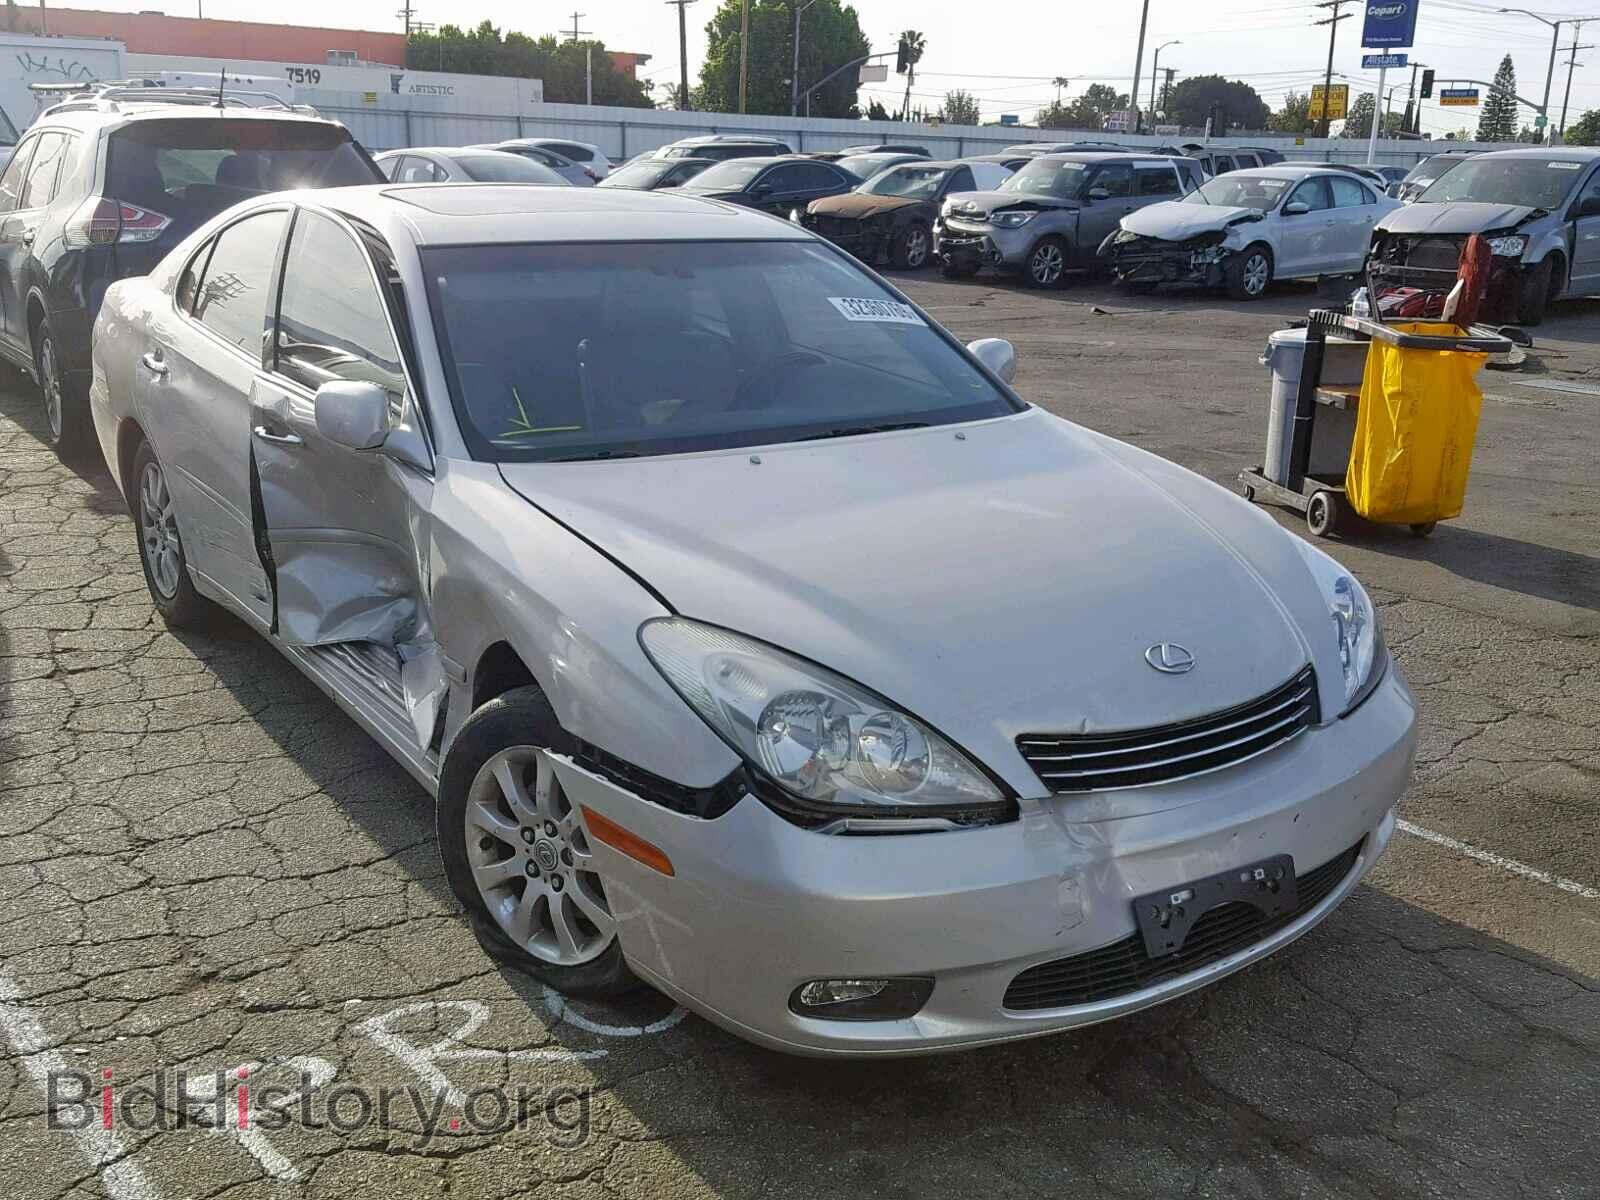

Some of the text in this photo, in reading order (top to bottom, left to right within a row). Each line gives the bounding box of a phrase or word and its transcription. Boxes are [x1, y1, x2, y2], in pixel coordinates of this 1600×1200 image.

[1368, 5, 1402, 16] Copart
[1366, 56, 1399, 65] Allstate
[285, 67, 321, 85] 7519
[408, 84, 455, 96] ARTISTIC
[1310, 109, 1342, 119] MAKET
